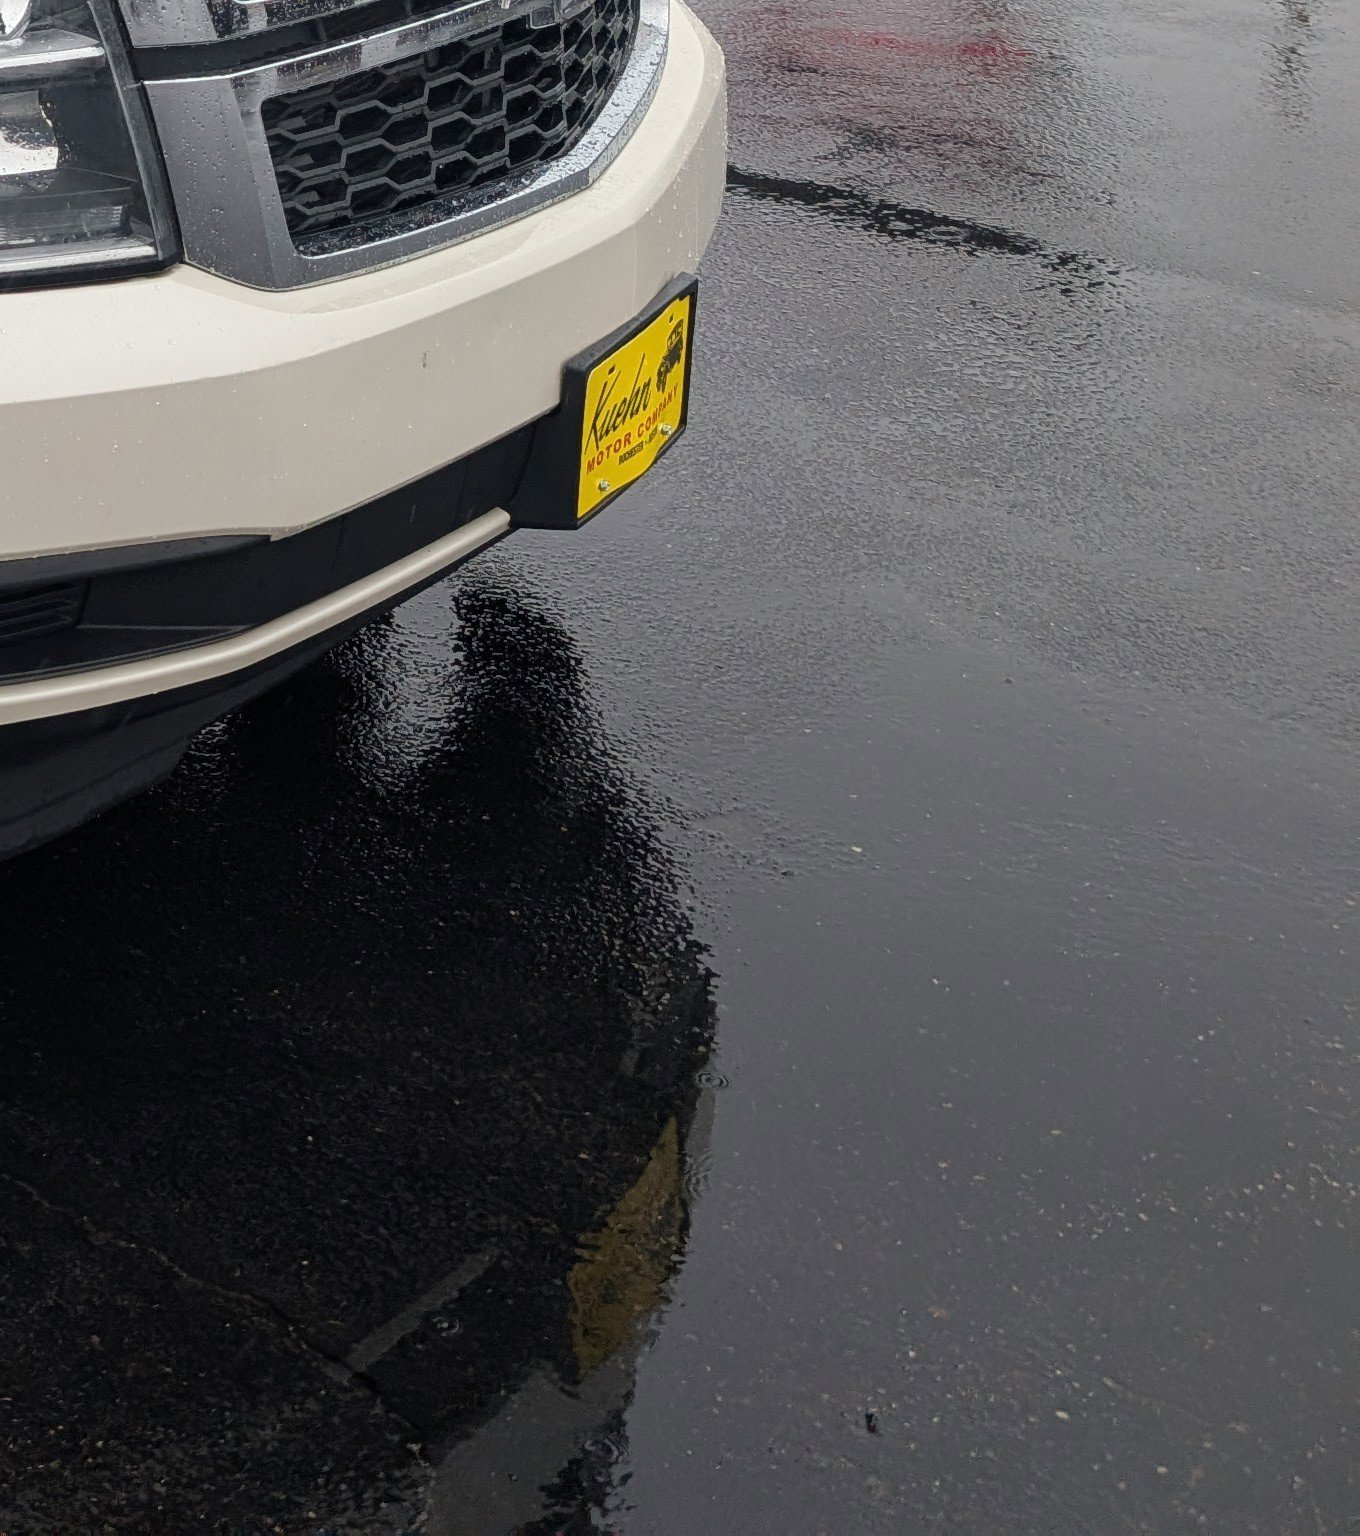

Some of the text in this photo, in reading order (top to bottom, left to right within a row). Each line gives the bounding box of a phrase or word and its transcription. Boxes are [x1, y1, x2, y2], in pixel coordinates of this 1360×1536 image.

[584, 352, 653, 456] Kuehn
[586, 381, 680, 476] MOTOR COMPANY
